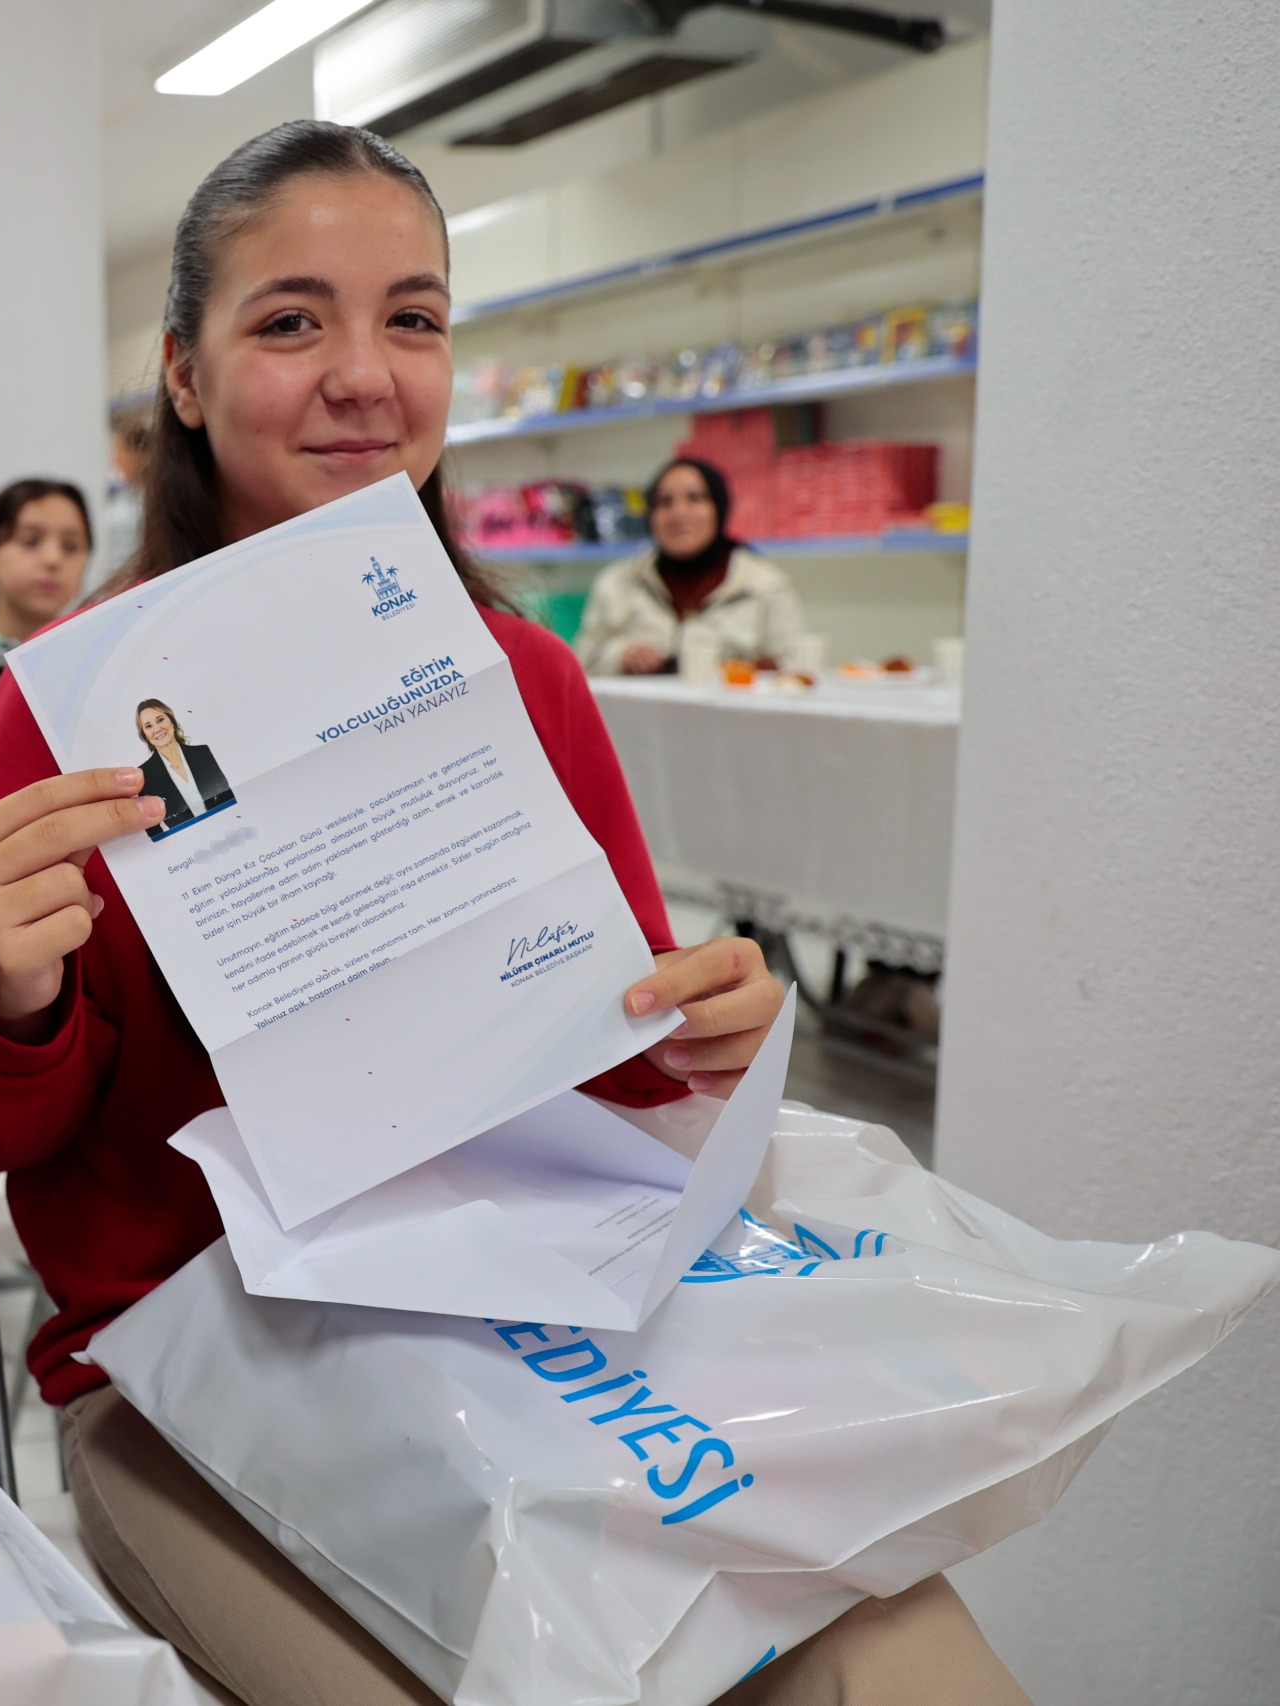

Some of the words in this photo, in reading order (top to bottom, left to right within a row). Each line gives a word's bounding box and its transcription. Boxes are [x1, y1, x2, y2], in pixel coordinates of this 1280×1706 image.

[371, 589, 418, 617] KONAK
[381, 602, 416, 621] BELEDİYESİ
[400, 655, 455, 688] EĞİTİM
[315, 669, 464, 744] YOLCULUĞUNUZDA
[373, 712, 406, 735] YAN
[406, 682, 470, 719] YANAYIZ
[182, 892, 189, 900] 11
[192, 883, 212, 895] Ekim
[215, 869, 241, 884] Dünya
[244, 861, 256, 870] Kız
[259, 841, 297, 863] Çocukları
[300, 828, 322, 842] Günü
[370, 778, 425, 809] çocuklarımızın
[441, 745, 491, 775] gençlerimizin
[190, 898, 215, 913] eğitim
[219, 866, 279, 900] yolculuklarında
[284, 844, 326, 869] yanlarında
[331, 823, 368, 844] olmaktan
[372, 808, 396, 823] büyük
[401, 790, 433, 809] mutluluk
[483, 758, 496, 768] Her
[231, 885, 275, 909] hayallerine
[279, 873, 299, 886] adım
[302, 862, 322, 875] adım
[324, 839, 368, 865] yaklaşırken
[371, 817, 410, 842] gösterdiği
[436, 794, 457, 808] emek
[470, 771, 504, 790] kararlılık
[167, 858, 195, 875] Sevgili
[265, 928, 289, 943] eğitim
[291, 913, 320, 930] sadece
[320, 902, 338, 915] bilgi
[339, 885, 373, 905] edinmek
[396, 866, 413, 877] aynı
[414, 847, 450, 868] zamanda
[451, 831, 483, 849] özgüven
[203, 926, 224, 940] bizler
[226, 918, 241, 928] için
[241, 905, 267, 920] büyük
[267, 899, 278, 908] bir
[280, 888, 302, 902] ilham
[224, 961, 254, 979] kendini
[254, 951, 276, 965] ifade
[278, 929, 318, 953] edebilmek
[329, 911, 352, 926] kendi
[353, 888, 399, 917] geleceğinizi
[399, 881, 416, 891] inşa
[475, 838, 500, 853] bugün
[501, 822, 531, 840] attığınız
[232, 983, 245, 992] her
[248, 968, 276, 985] adımla
[277, 954, 304, 972] yarının
[306, 941, 328, 957] güçlü
[328, 923, 361, 944] bireyleri
[247, 1002, 273, 1018] Konak
[274, 980, 314, 1004] Belediyesi
[345, 953, 369, 968] sizlere
[370, 933, 408, 955] inancımız
[427, 916, 441, 925] Her
[443, 902, 469, 918] zaman
[500, 962, 534, 982] NİLÜFER
[534, 945, 567, 966] ÇINARLI
[567, 931, 594, 948] MUTLU
[511, 973, 534, 987] KONAK
[535, 958, 565, 976] BELEDİYE
[565, 944, 592, 961] BAŞKANI
[255, 1011, 287, 1031] Yolunuz
[308, 981, 346, 1003] başarınız
[347, 970, 368, 984] daim
[482, 1318, 754, 1526] EDİYESİ
